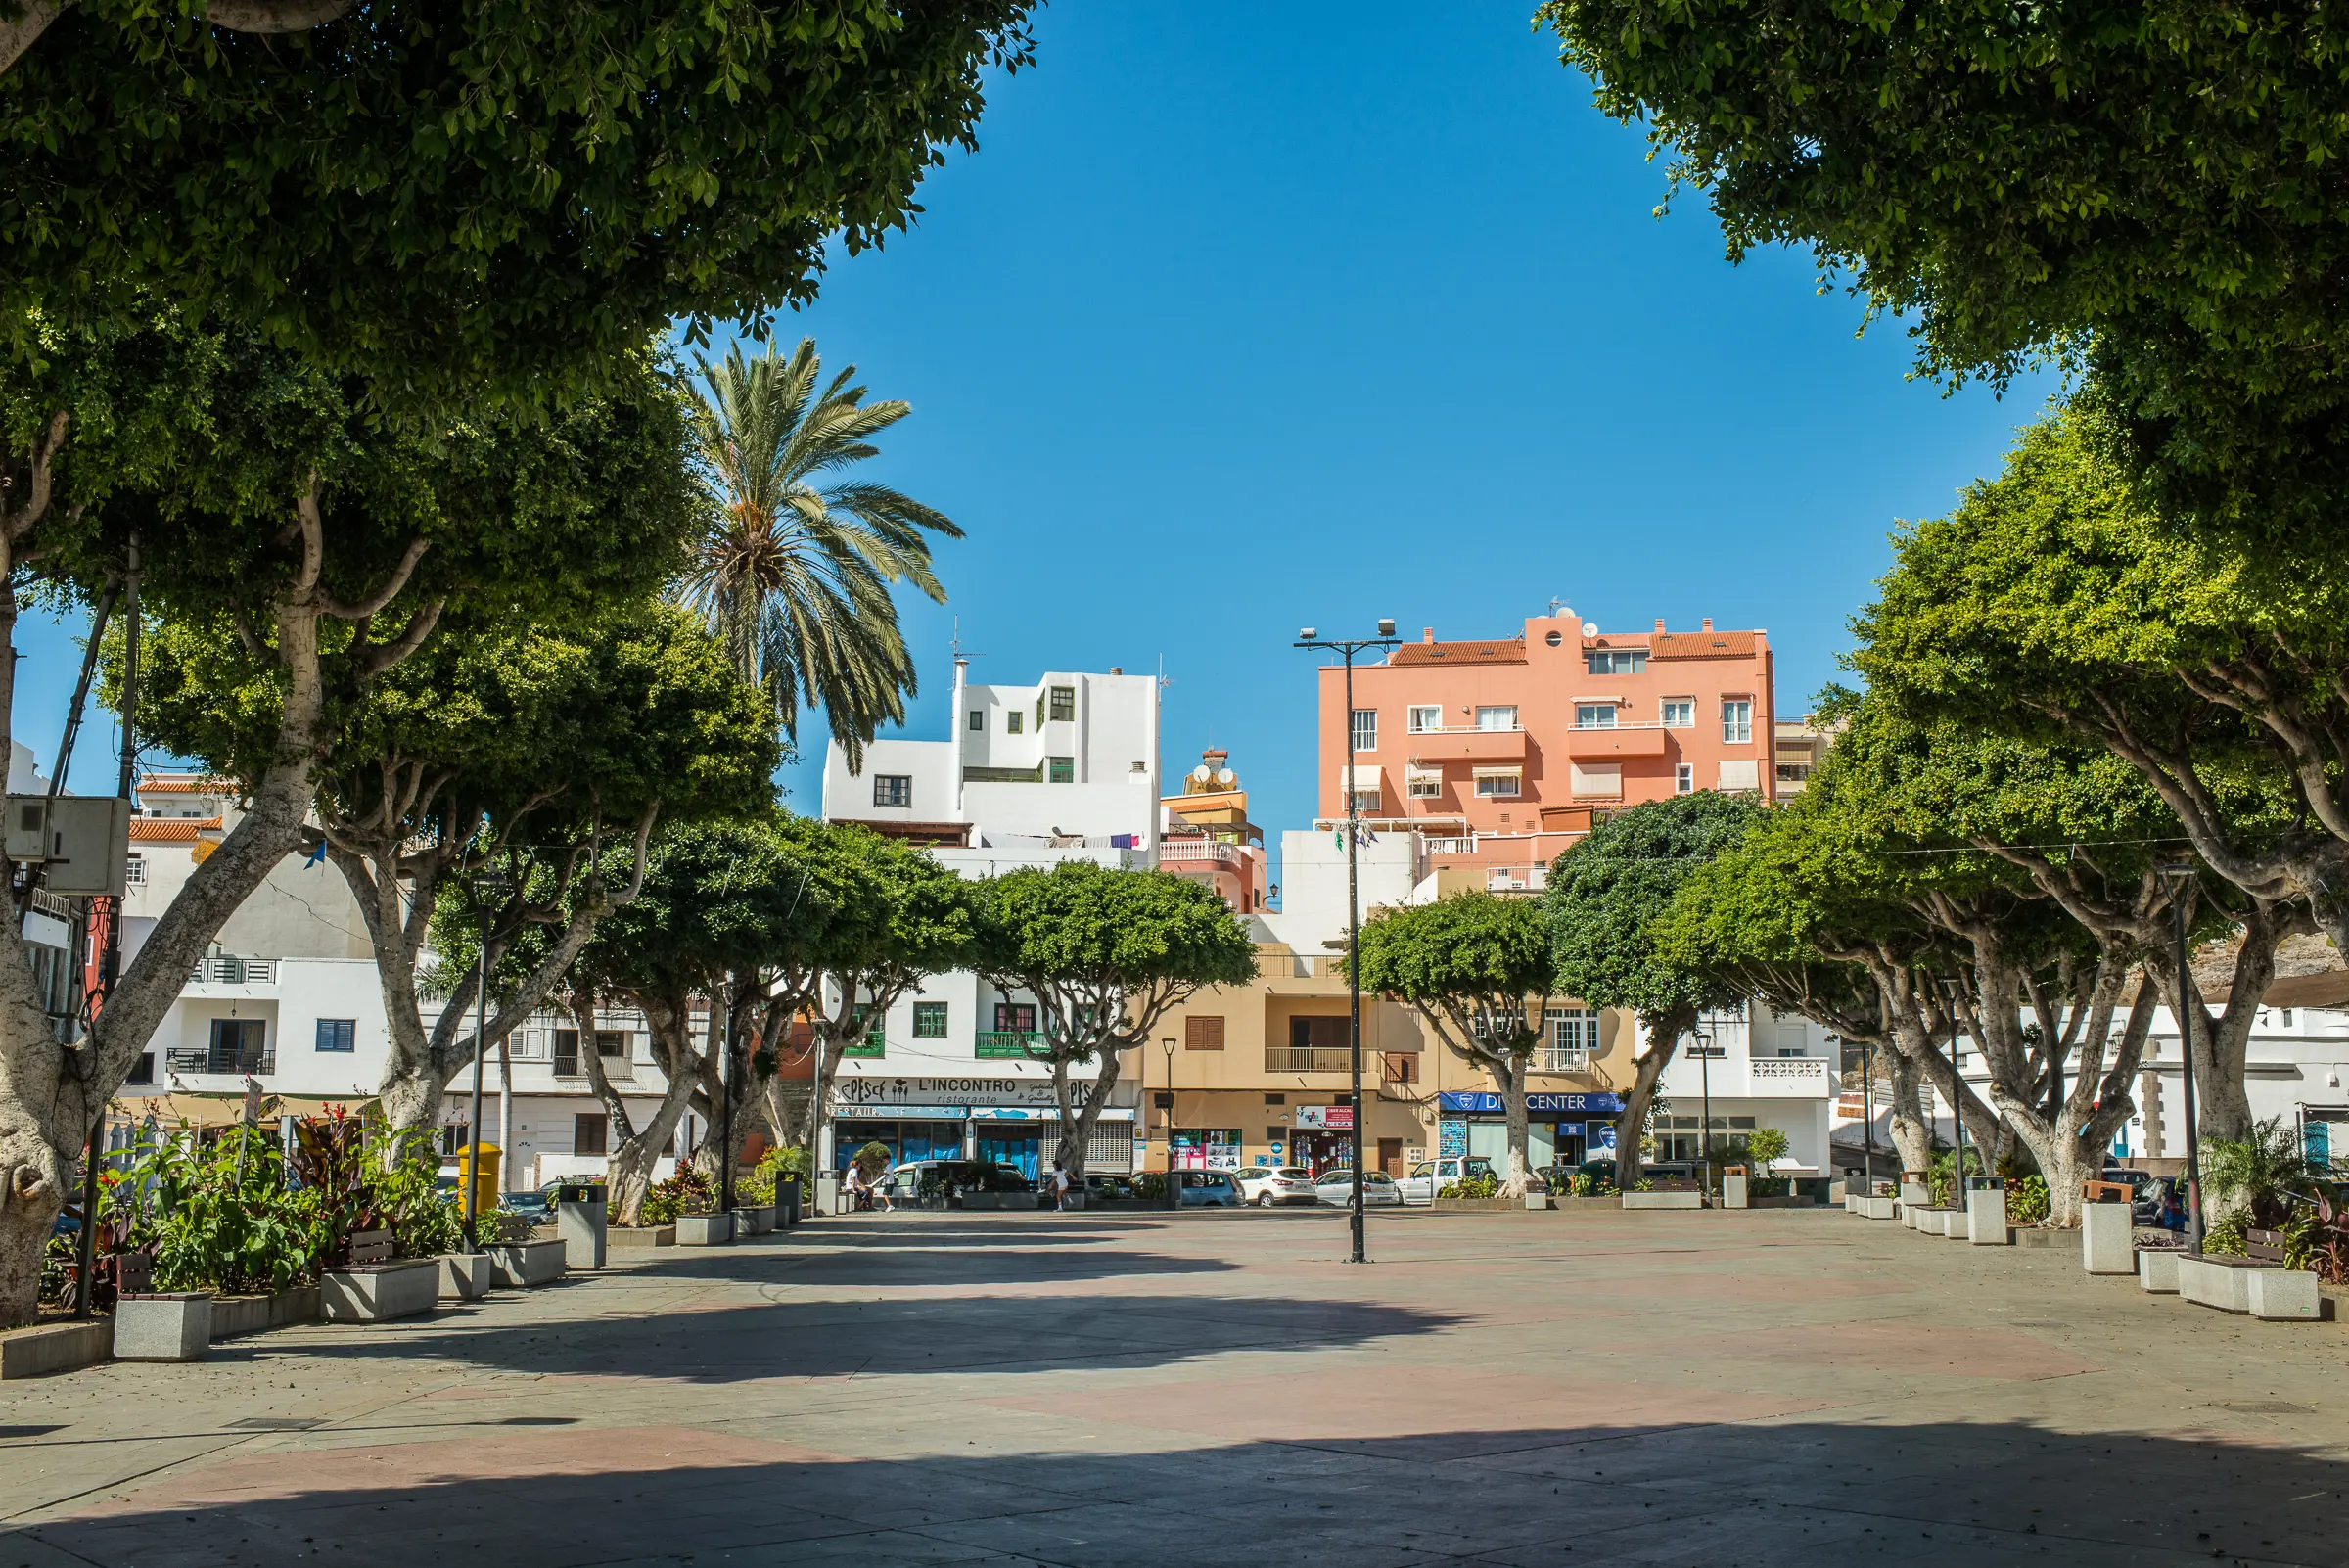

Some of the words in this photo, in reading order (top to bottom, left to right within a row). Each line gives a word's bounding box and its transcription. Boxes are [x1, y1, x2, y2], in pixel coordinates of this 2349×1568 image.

[919, 1079, 1016, 1092] L'INCONTRO
[1070, 1080, 1091, 1105] PES
[937, 1095, 997, 1105] ristorante
[1486, 1095, 1501, 1109] DI
[1525, 1094, 1586, 1109] CENTER
